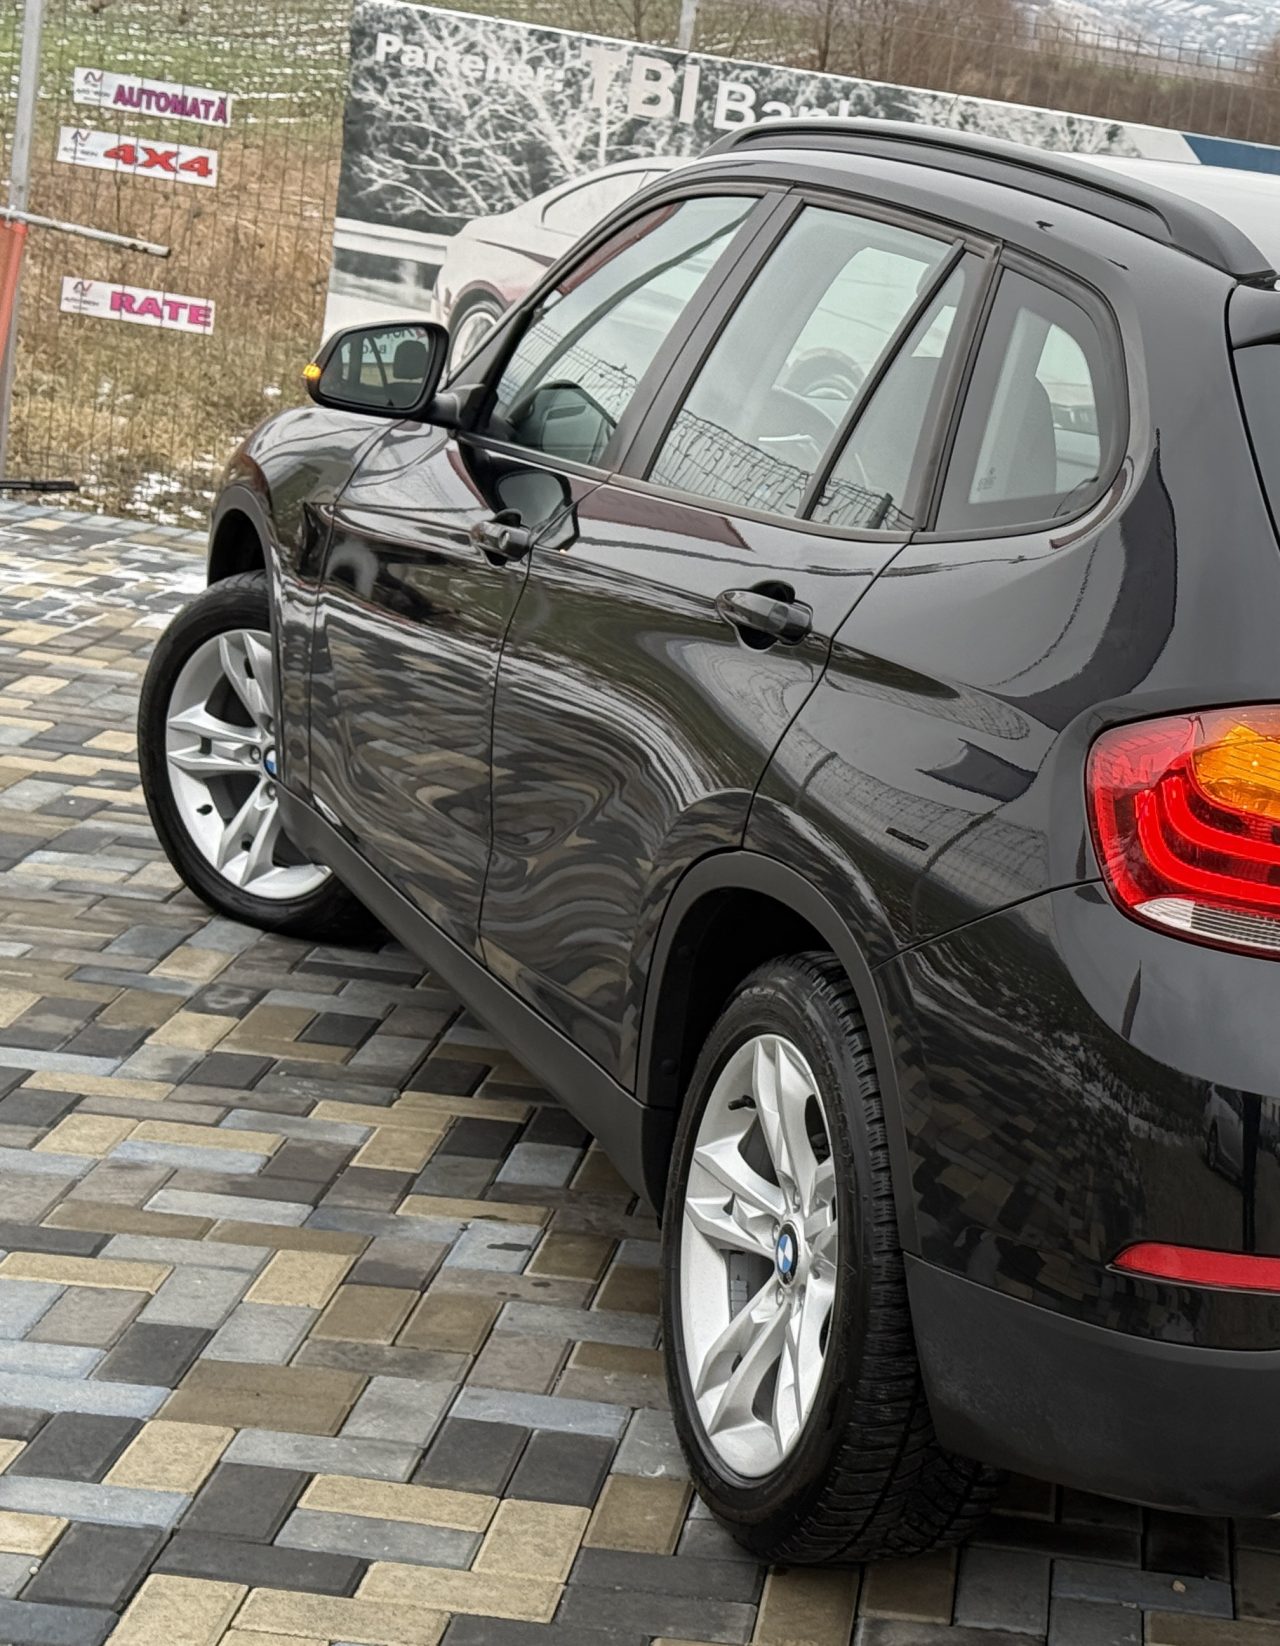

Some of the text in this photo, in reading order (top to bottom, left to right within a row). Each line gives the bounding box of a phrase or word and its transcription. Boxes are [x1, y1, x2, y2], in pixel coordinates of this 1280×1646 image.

[581, 44, 700, 124] TBI
[103, 143, 213, 178] 4X4
[110, 291, 212, 327] RATE
